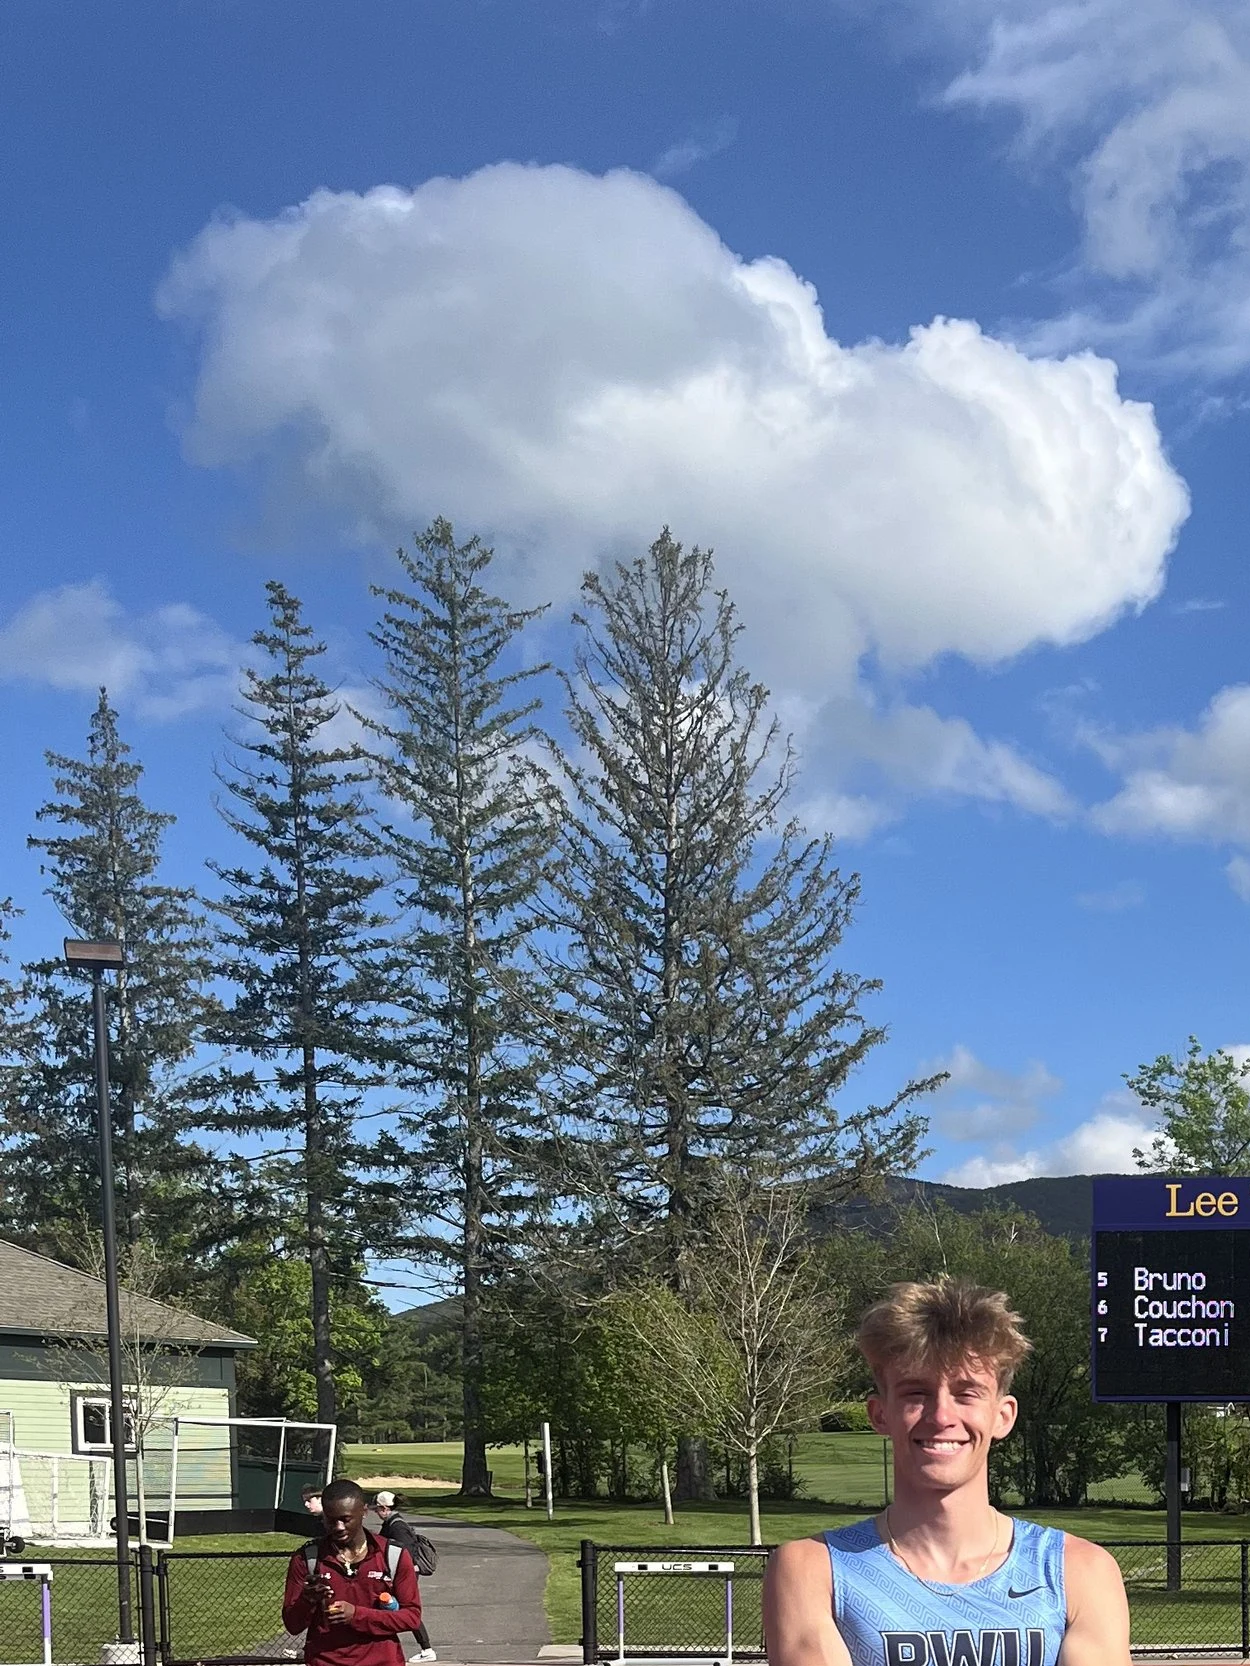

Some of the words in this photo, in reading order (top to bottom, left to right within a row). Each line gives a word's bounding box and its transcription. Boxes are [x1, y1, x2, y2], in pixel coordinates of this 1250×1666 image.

[1165, 1184, 1238, 1216] Lee
[1097, 1272, 1108, 1287] 5
[1134, 1267, 1206, 1291] Bruno
[1097, 1300, 1108, 1315] 6
[1134, 1295, 1234, 1318] Couchon
[1097, 1327, 1108, 1342] 7
[1134, 1323, 1228, 1346] Tacconi
